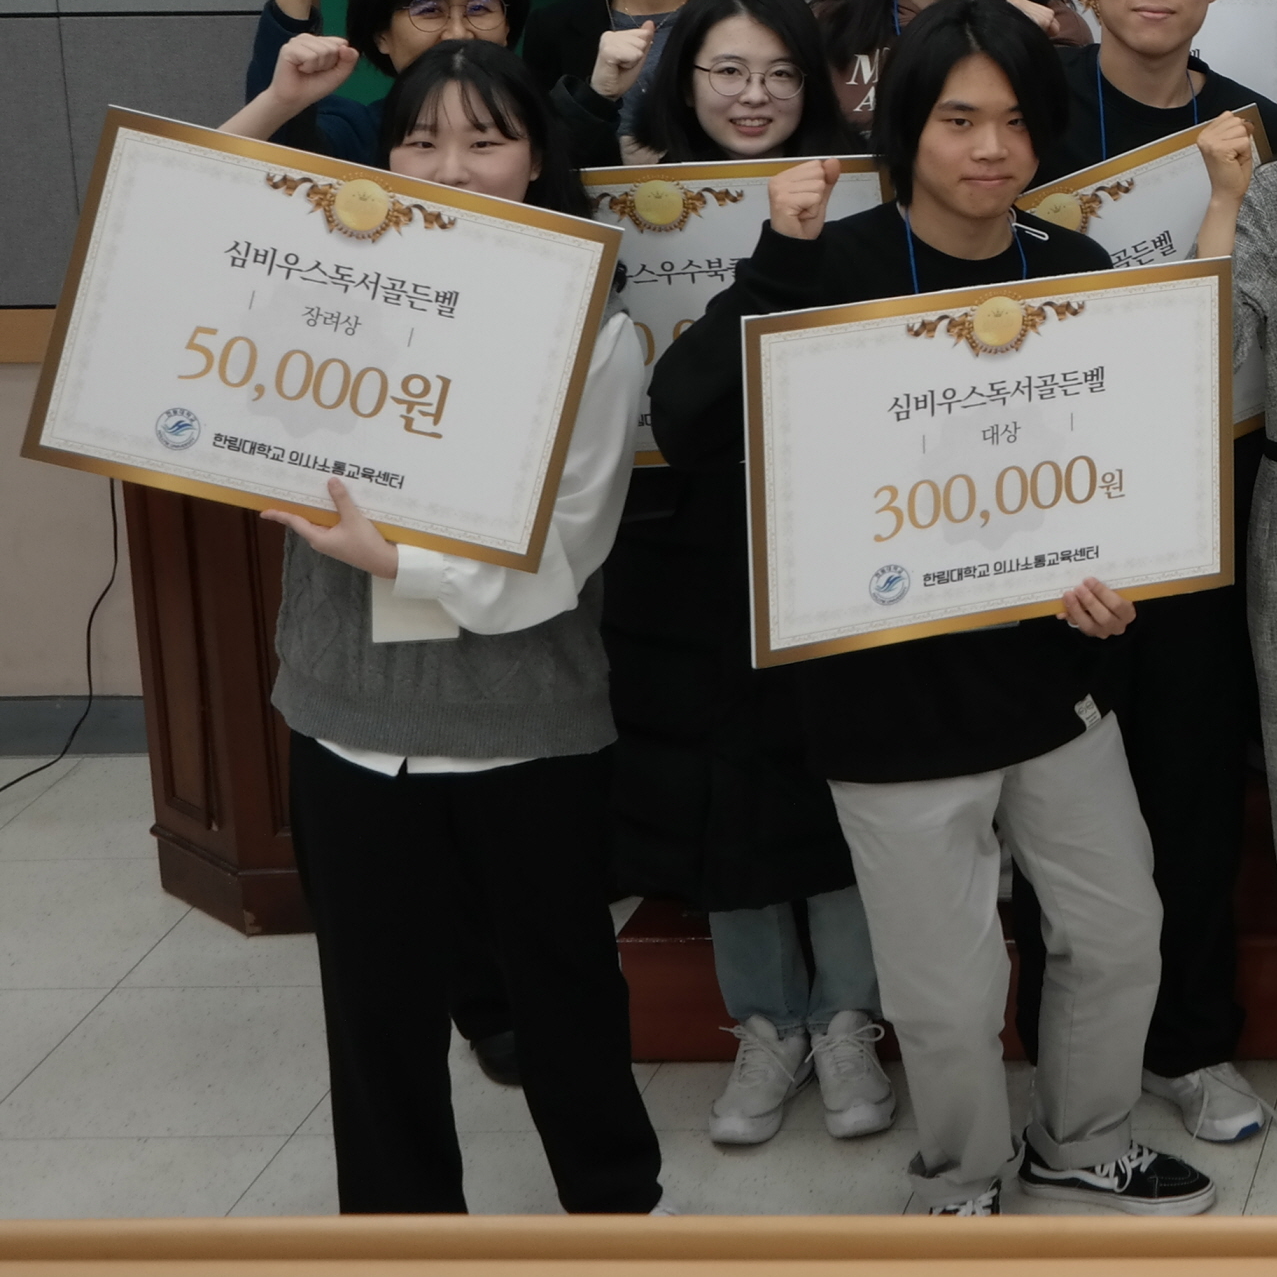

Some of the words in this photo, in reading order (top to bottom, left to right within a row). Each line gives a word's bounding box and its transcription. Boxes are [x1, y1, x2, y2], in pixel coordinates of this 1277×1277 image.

[223, 239, 461, 320] 심비우스독서골든벨
[301, 305, 362, 337] 장려상
[177, 324, 452, 440] 50,000원
[886, 365, 1106, 423] 심비우스독서골든벨
[212, 431, 286, 463] 한림대학교
[287, 449, 406, 491] 의사소통교육센터
[980, 421, 1022, 448] 대상
[871, 455, 1126, 543] 300,000원
[922, 562, 991, 588] 한림대학교
[992, 543, 1100, 577] 의사소통교육센터
